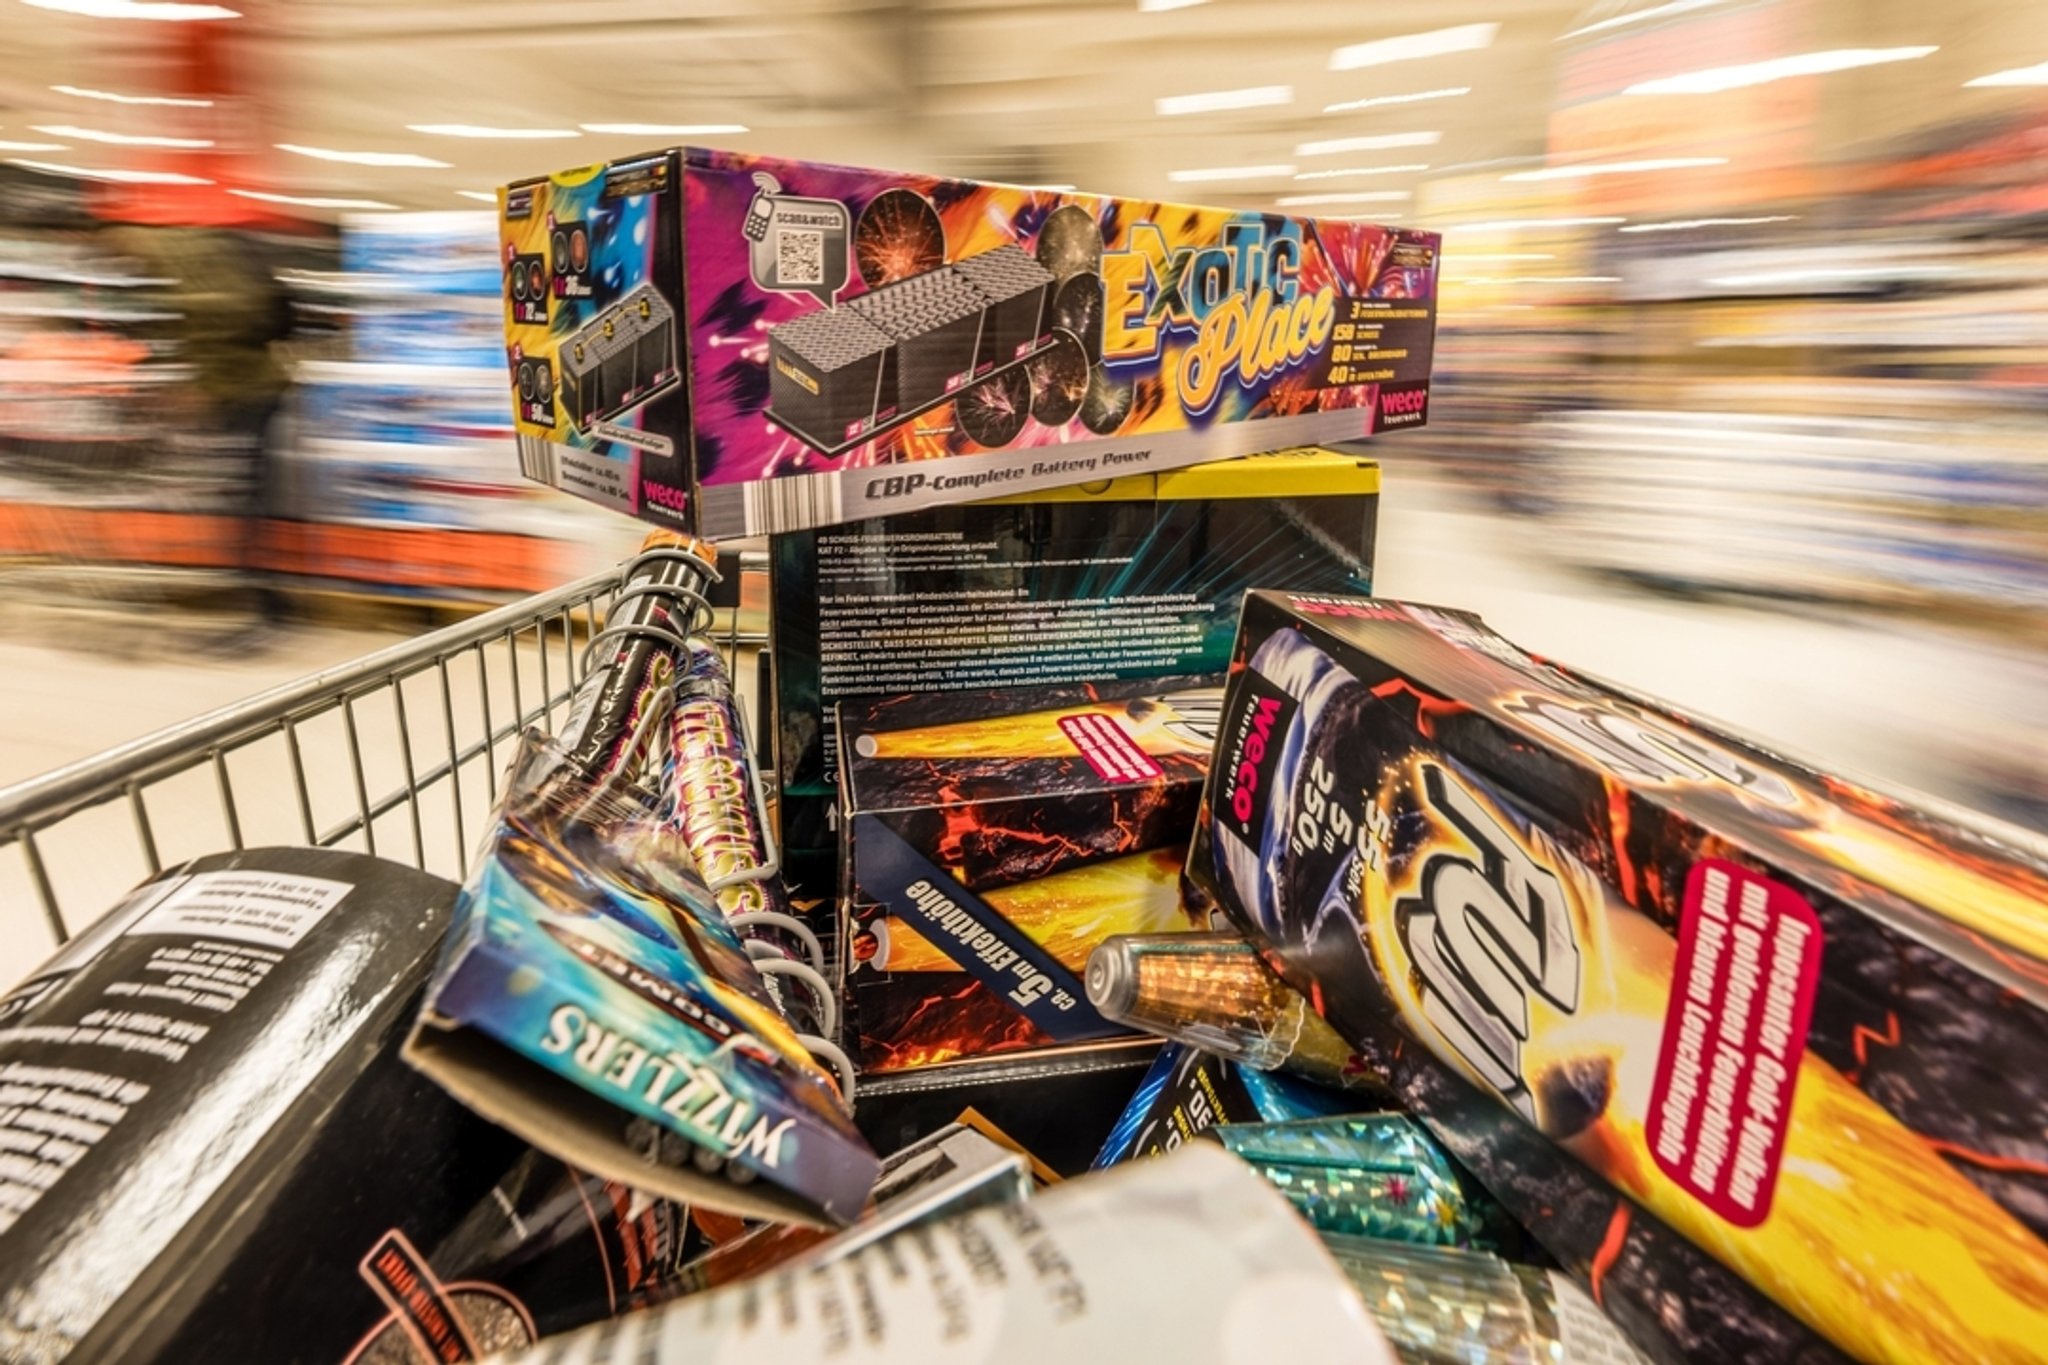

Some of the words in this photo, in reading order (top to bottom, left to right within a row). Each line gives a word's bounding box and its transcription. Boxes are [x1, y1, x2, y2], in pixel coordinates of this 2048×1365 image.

[1100, 224, 1301, 362] EXOTIC
[1178, 287, 1335, 411] Place
[1328, 366, 1348, 384] 40
[1331, 345, 1352, 362] 80
[1381, 390, 1424, 415] weco
[1384, 413, 1421, 425] feuerwerk
[643, 480, 685, 510] weco
[647, 501, 684, 521] feuerwerk
[865, 467, 1024, 499] CBP-Complete
[1032, 457, 1097, 477] Battery
[1102, 449, 1152, 466] Power
[1225, 693, 1260, 799] feuerwerk
[1233, 697, 1282, 823] weco
[905, 878, 1021, 973] Effekthöhe
[1700, 866, 1731, 920] und
[1739, 880, 1771, 930] mit
[1050, 987, 1077, 1012] ca.
[1687, 915, 1728, 1005] blauen
[1718, 923, 1762, 1048] goldenen
[540, 1004, 797, 1168] WIZZLERS
[1656, 1000, 1713, 1166] Leuchtkugeln
[1689, 1041, 1745, 1195] Feuerblüten
[1727, 1053, 1788, 1212] Gold-Vulkan
